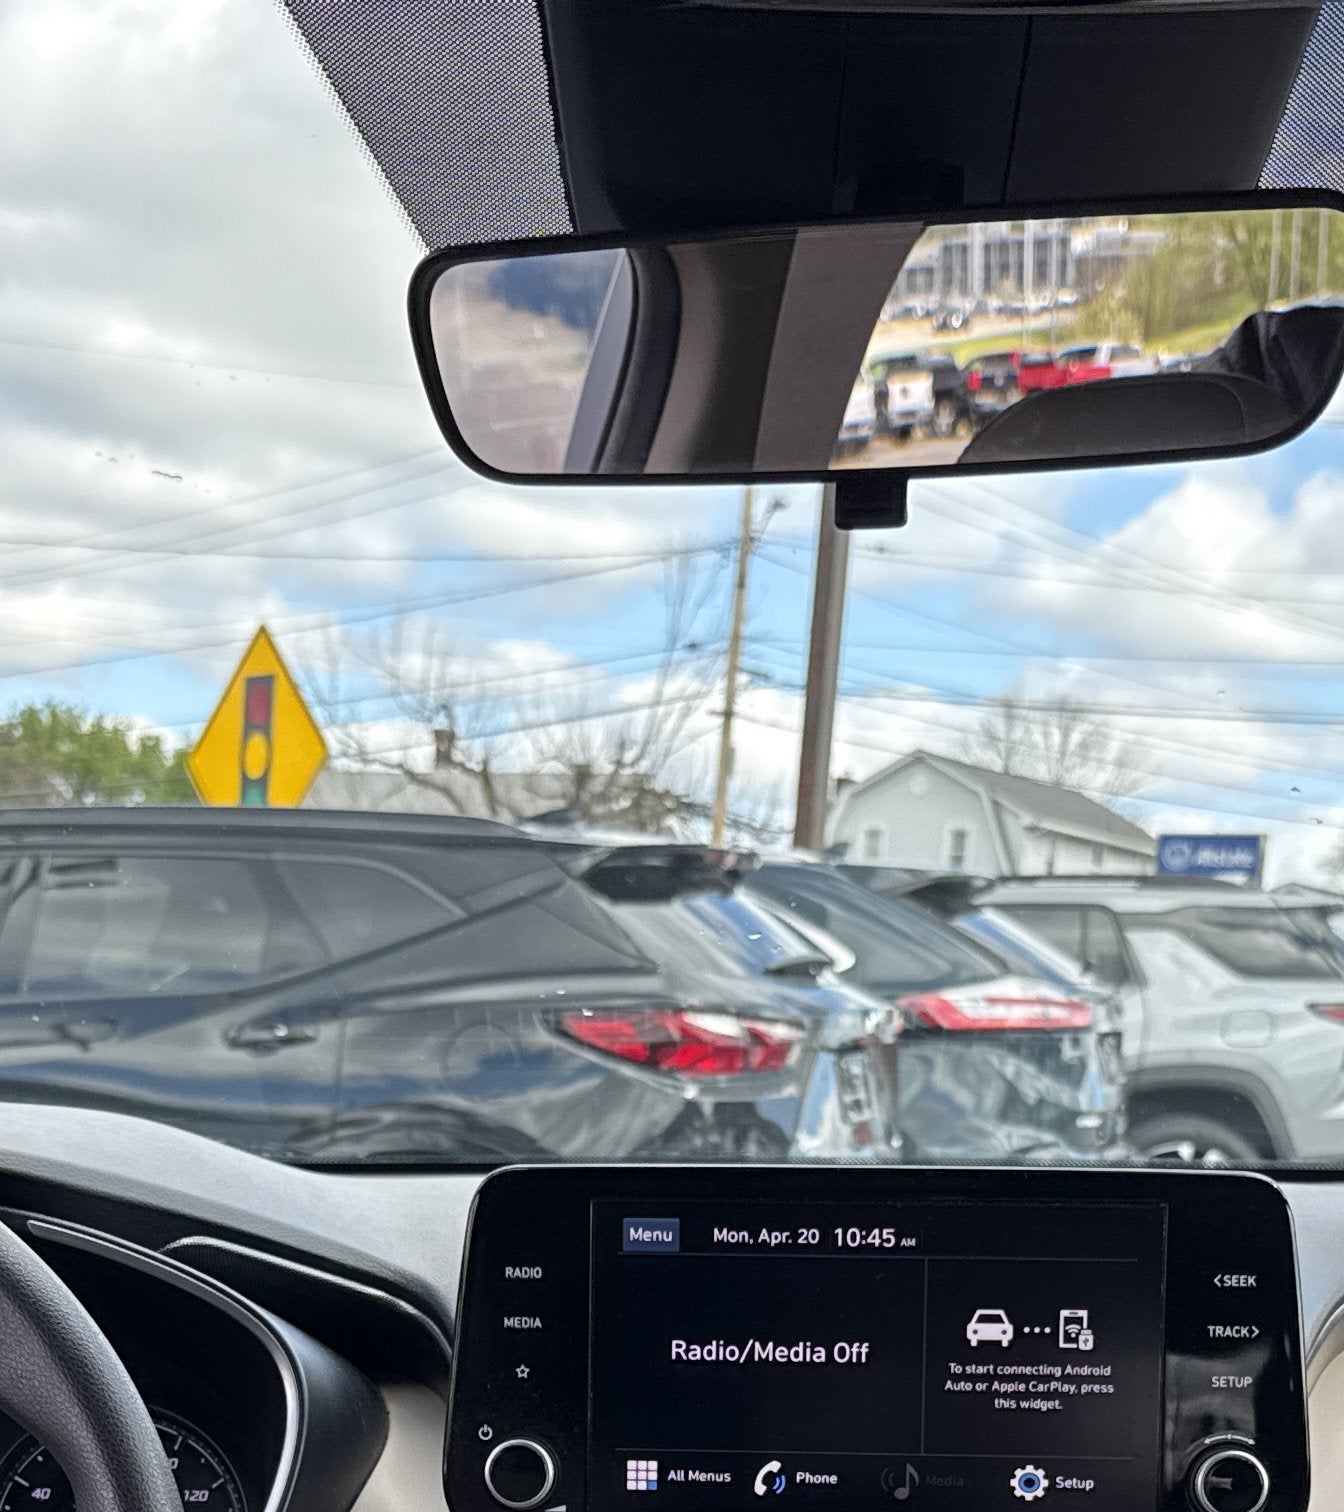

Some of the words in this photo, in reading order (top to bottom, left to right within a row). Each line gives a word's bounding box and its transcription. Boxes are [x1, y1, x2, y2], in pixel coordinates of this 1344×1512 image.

[630, 1227, 672, 1241] Menu
[713, 1227, 753, 1244] Mon,
[758, 1228, 792, 1246] Apr.
[798, 1228, 819, 1244] 20
[834, 1227, 896, 1247] 10:45
[900, 1238, 915, 1247] AM
[505, 1267, 542, 1279] RADIO
[504, 1316, 542, 1328] MEDIA
[672, 1339, 825, 1364] Radio/Media
[834, 1341, 869, 1363] Off
[949, 1363, 962, 1374] To
[966, 1364, 992, 1374] start
[997, 1364, 1061, 1379] connecting
[1065, 1364, 1111, 1376] Android
[945, 1380, 972, 1392] Auto
[977, 1382, 988, 1391] or
[992, 1381, 1024, 1395] Apple
[1029, 1381, 1077, 1396] CarPlay,
[1081, 1384, 1114, 1397] press
[1212, 1375, 1253, 1388] SETUP
[995, 1398, 1016, 1409] this
[1020, 1398, 1062, 1413] widget.
[668, 1469, 685, 1482] All
[690, 1470, 731, 1482] Menus
[796, 1471, 837, 1485] Phone
[926, 1474, 965, 1488] Media
[1056, 1475, 1094, 1492] Setup
[31, 1488, 51, 1500] 40
[183, 1490, 209, 1502] 120
